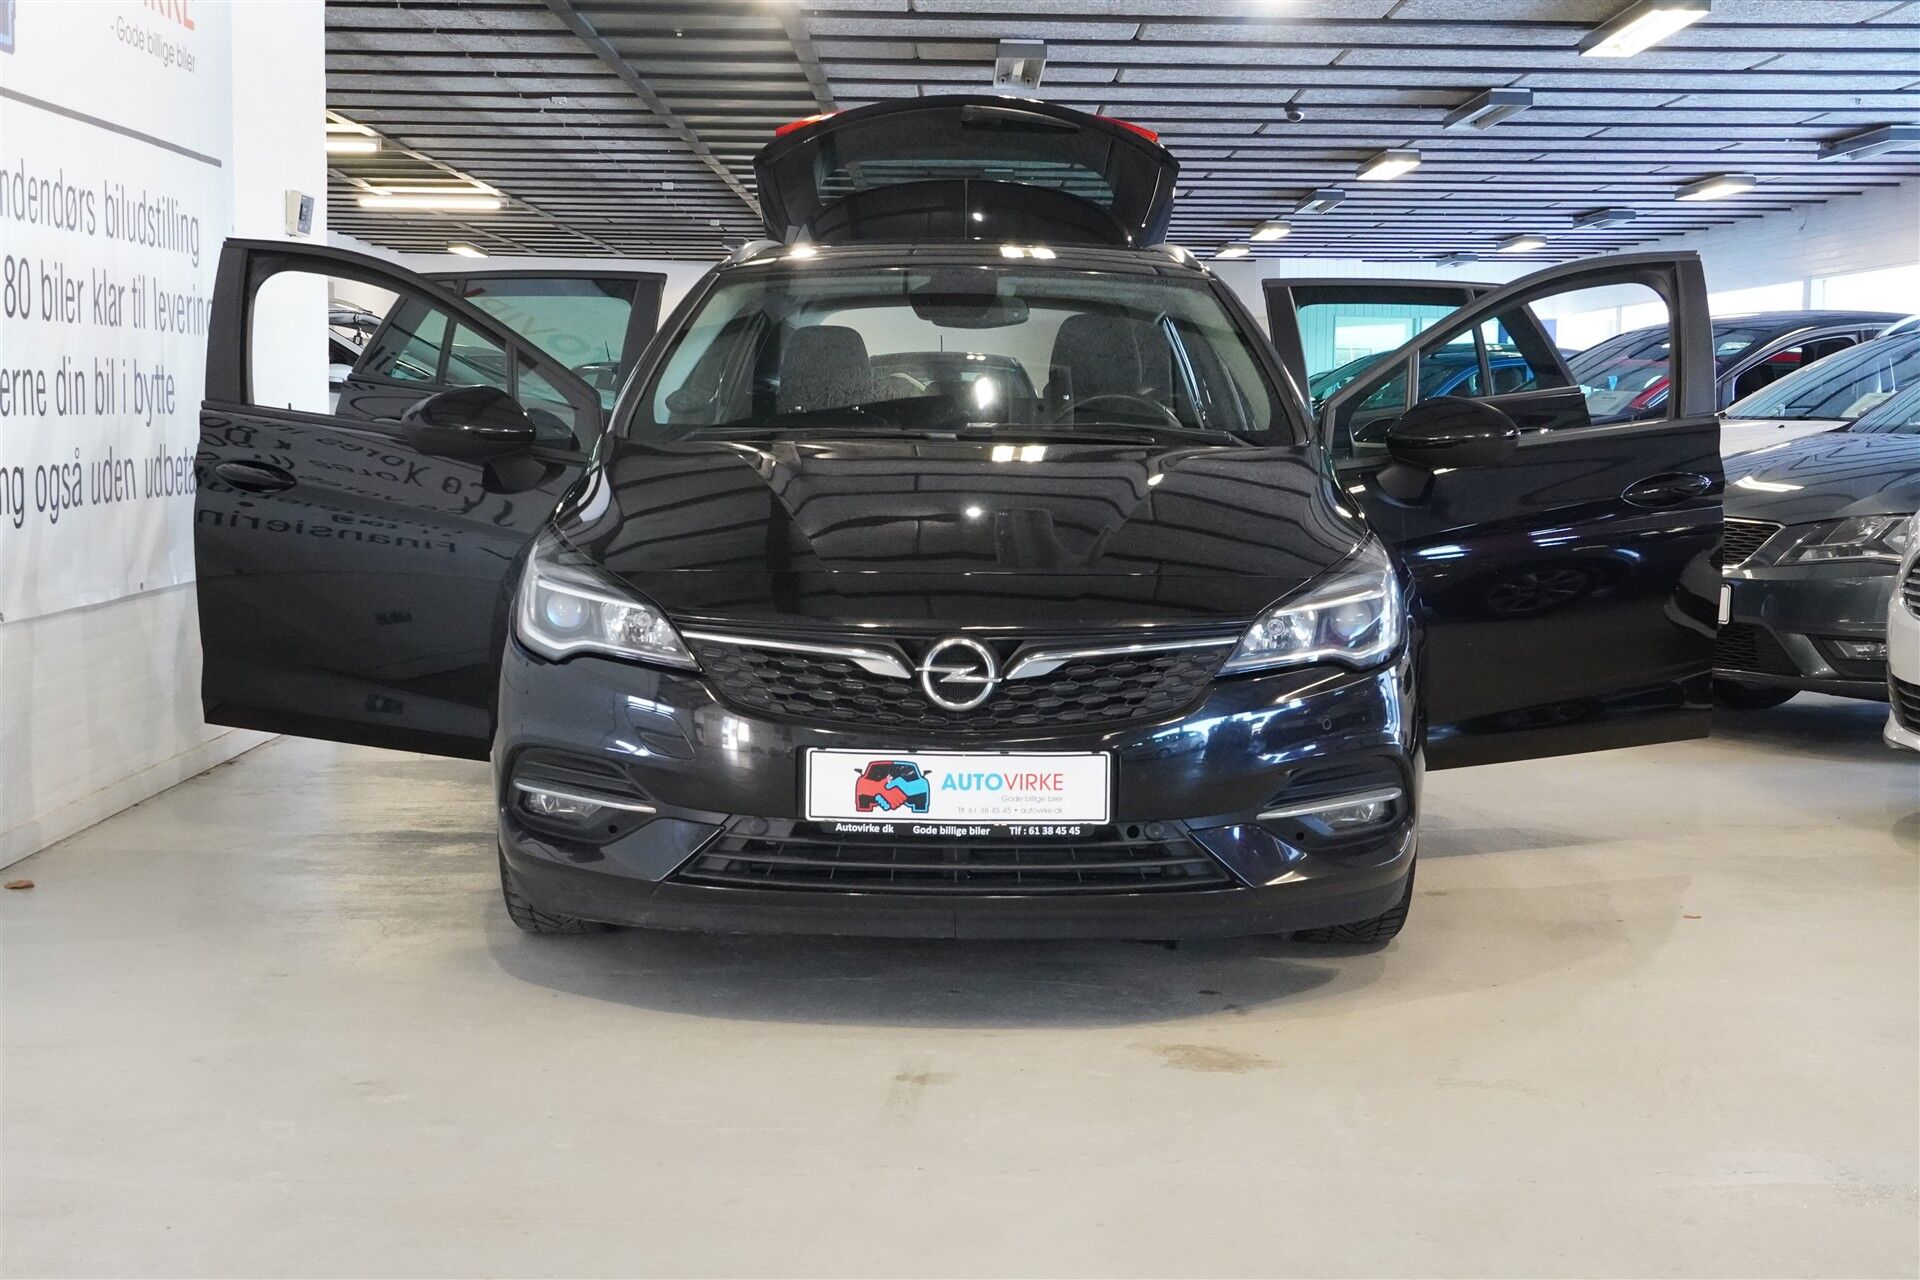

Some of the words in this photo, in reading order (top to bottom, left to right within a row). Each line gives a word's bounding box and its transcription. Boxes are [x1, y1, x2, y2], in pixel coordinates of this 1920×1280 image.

[116, 15, 145, 51] Gode
[146, 28, 175, 68] billige
[176, 43, 196, 73] biler
[104, 179, 199, 268] biludstilling
[4, 254, 31, 320] 80
[40, 258, 84, 324] biler
[92, 267, 125, 327] klar
[131, 274, 146, 330] til
[56, 355, 86, 416] din
[94, 357, 115, 416] bil
[122, 358, 126, 415] i
[133, 358, 175, 427] bytte
[35, 447, 83, 525] også
[91, 445, 137, 505] uden
[144, 443, 199, 500] udbeta
[941, 773, 1063, 791] AUTOVIRKE
[835, 823, 880, 833] Autovirke
[912, 825, 938, 835] Gode
[939, 826, 967, 837] billige
[968, 827, 991, 836] biler
[1009, 826, 1022, 836] Tlf
[1028, 826, 1040, 836] 61
[1042, 826, 1054, 836] 38
[1055, 826, 1067, 836] 45
[1068, 826, 1081, 836] 45
